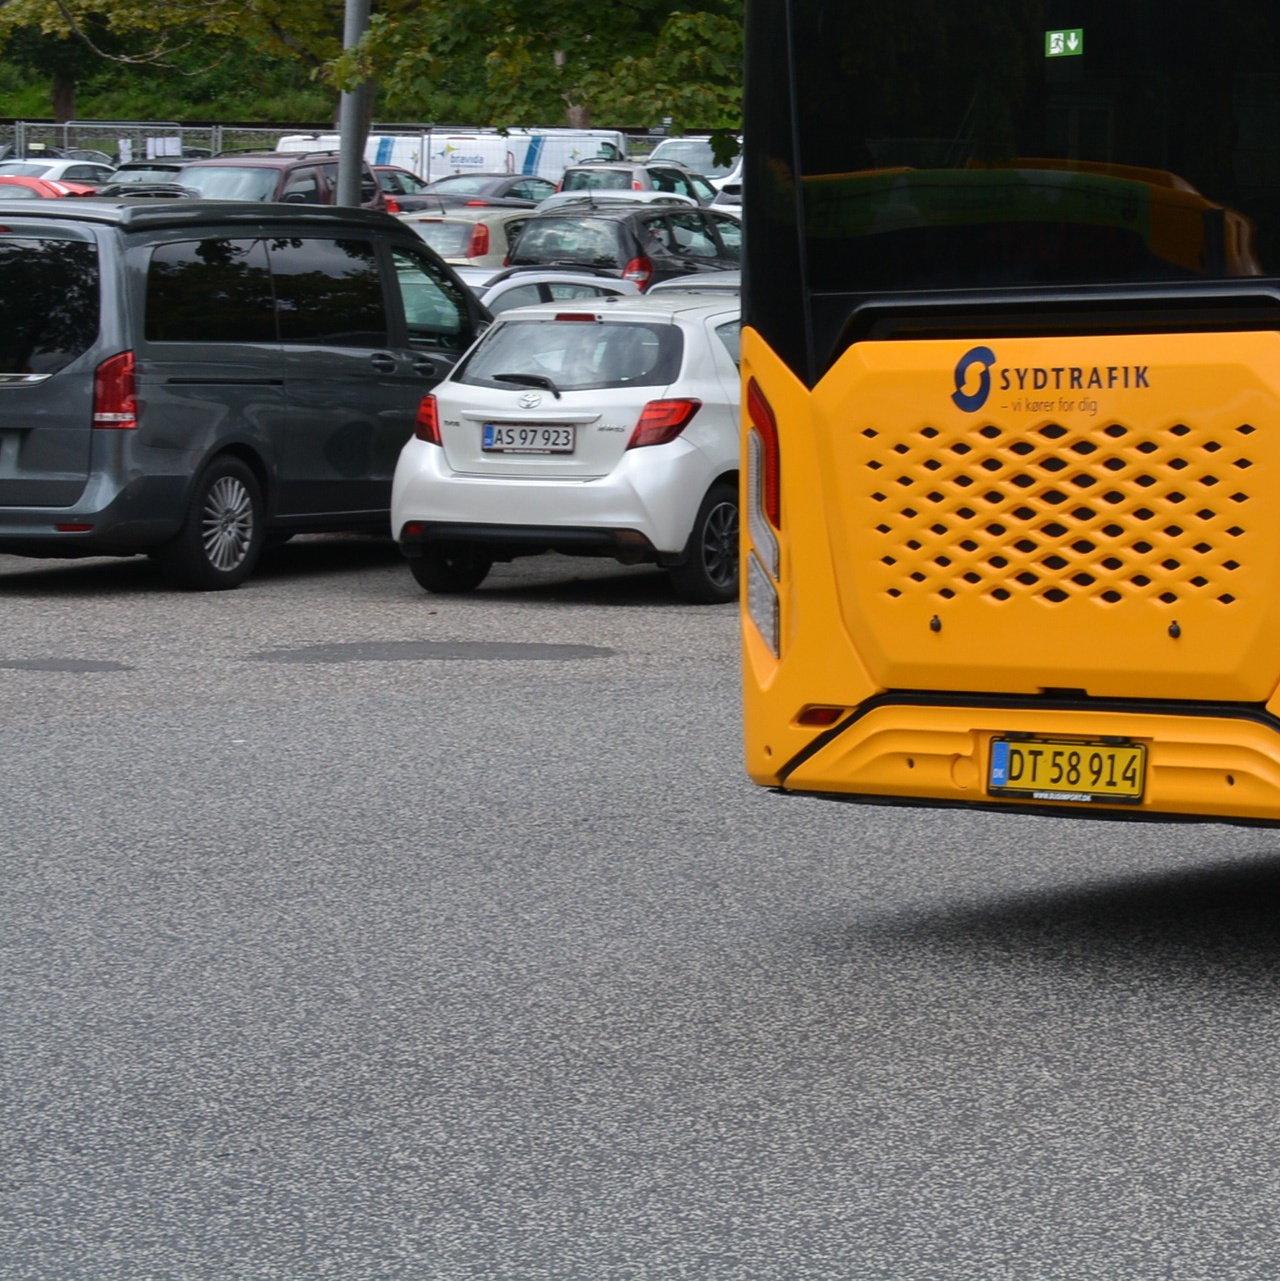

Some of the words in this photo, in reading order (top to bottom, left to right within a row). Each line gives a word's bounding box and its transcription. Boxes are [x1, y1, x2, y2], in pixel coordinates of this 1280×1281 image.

[450, 153, 484, 164] bravida
[1000, 366, 1150, 391] SYDTRAFIK
[1011, 399, 1022, 412] vi
[1025, 398, 1054, 413] kører
[1058, 397, 1075, 412] for
[1078, 397, 1098, 417] dig
[494, 429, 515, 445] AS
[519, 429, 538, 445] 97
[541, 429, 571, 446] 923
[1008, 749, 1044, 782] DT
[1050, 751, 1081, 785] 58
[1089, 752, 1138, 788] 914
